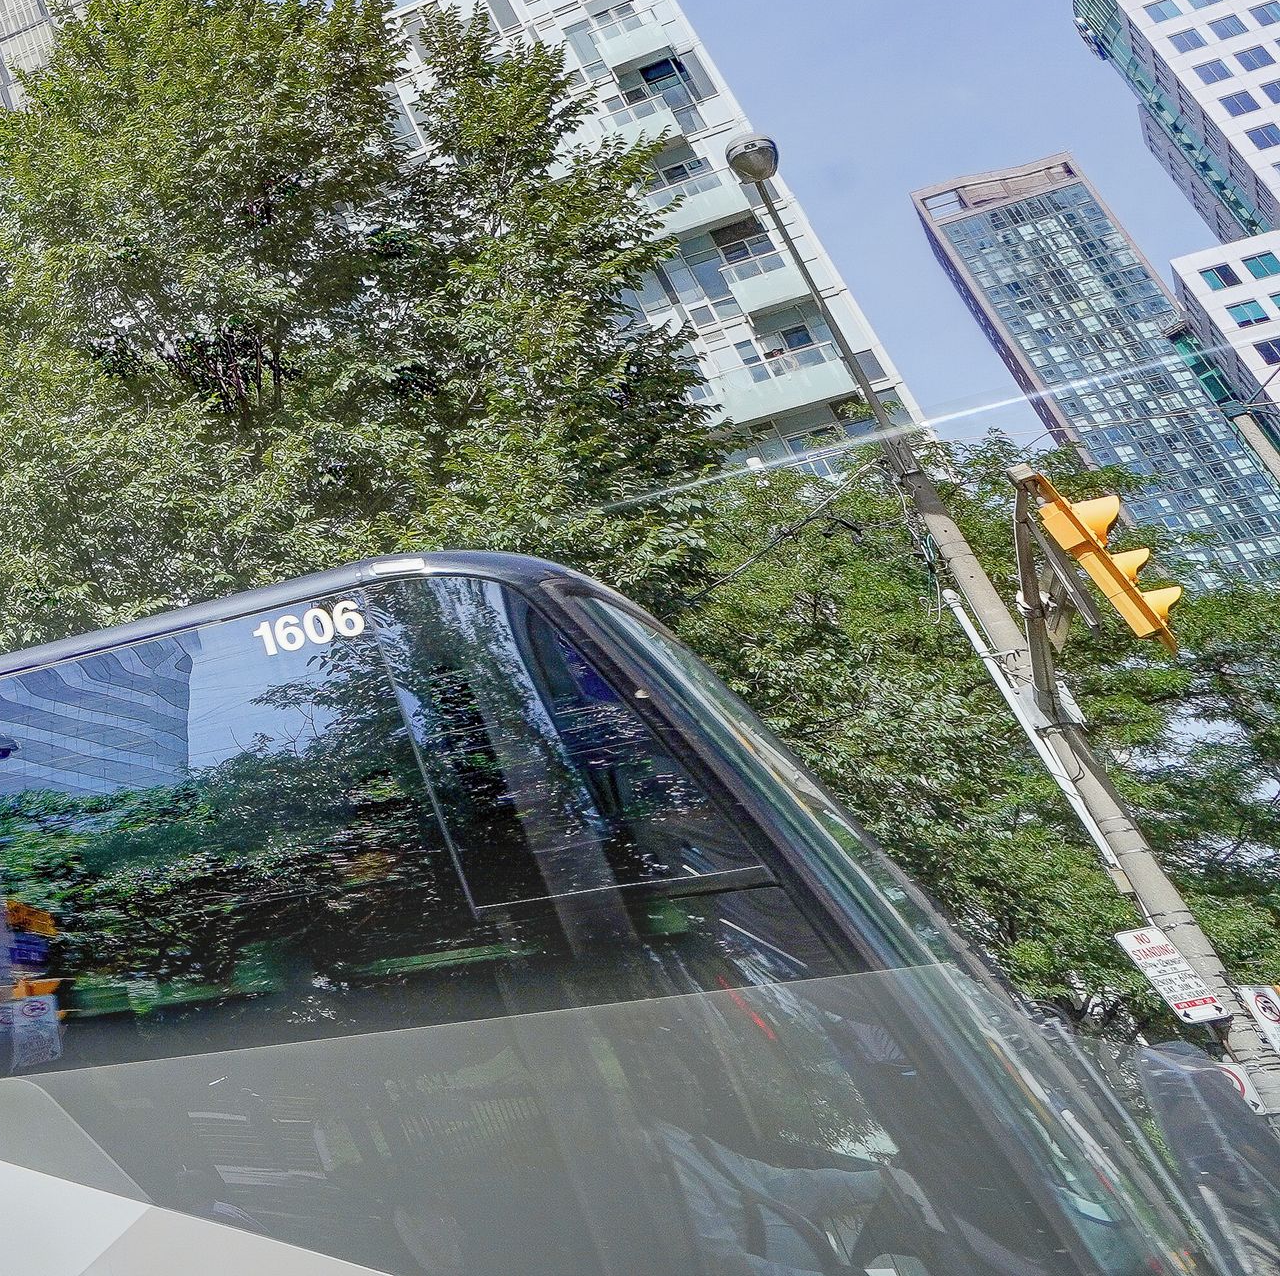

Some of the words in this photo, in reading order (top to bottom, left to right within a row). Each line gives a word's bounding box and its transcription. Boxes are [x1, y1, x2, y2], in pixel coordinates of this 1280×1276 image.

[252, 600, 366, 656] 1606
[1132, 932, 1151, 945] NO
[1131, 943, 1177, 961] STANDING
